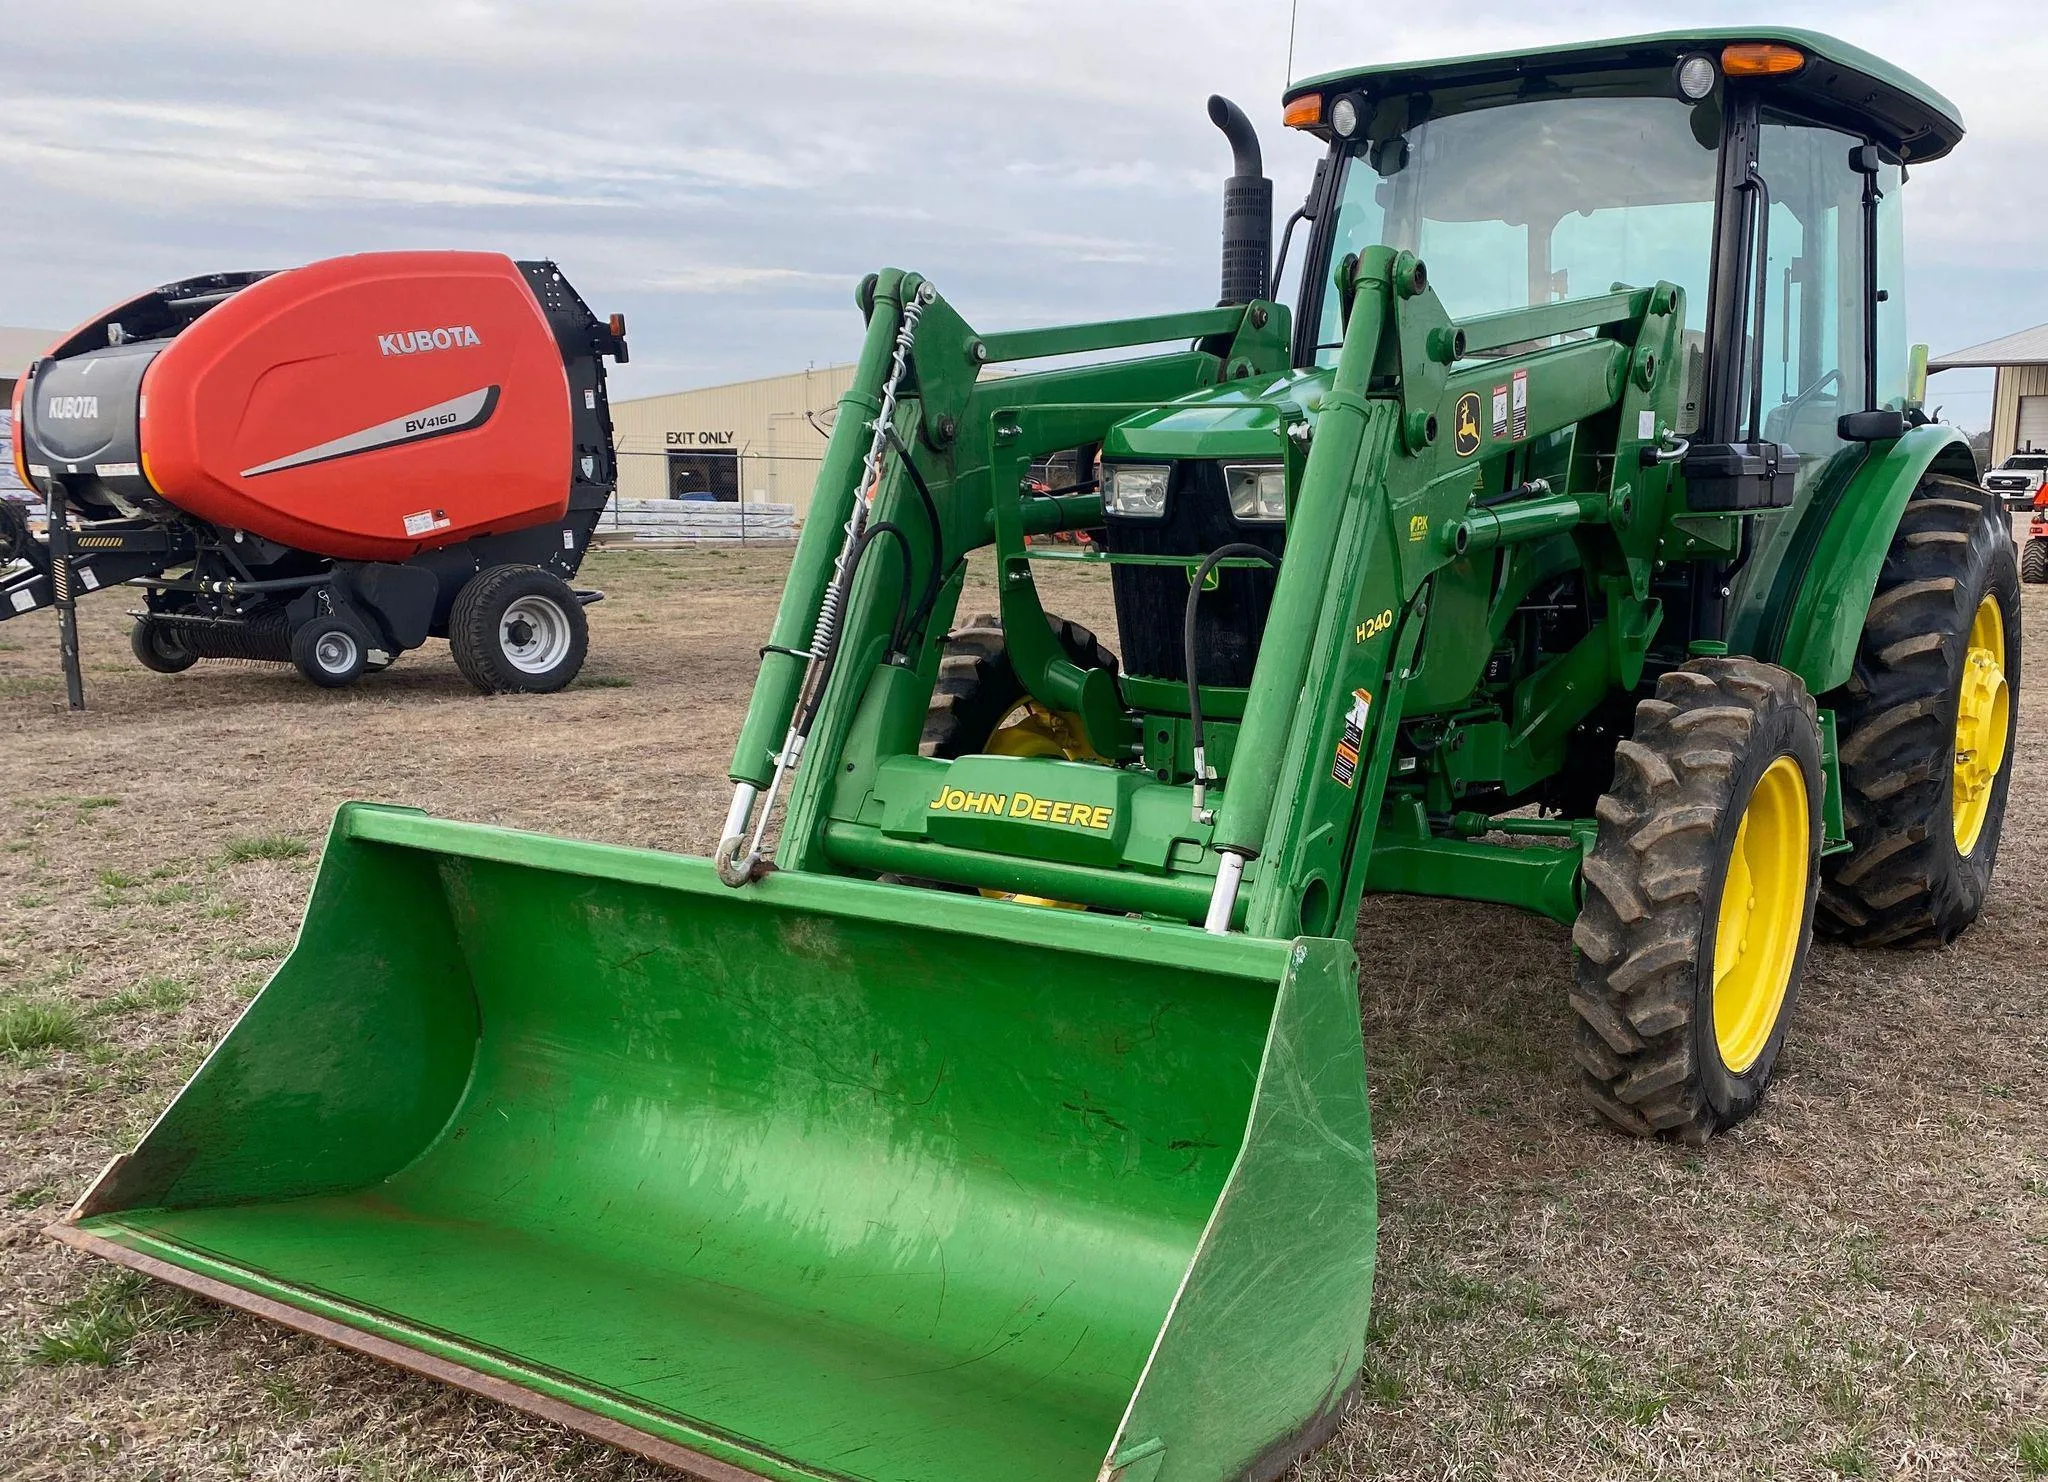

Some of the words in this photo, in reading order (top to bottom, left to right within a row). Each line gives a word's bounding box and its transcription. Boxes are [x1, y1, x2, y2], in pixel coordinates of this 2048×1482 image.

[378, 325, 481, 356] KUBOTA
[48, 396, 98, 419] KUBOTA
[405, 413, 457, 433] BV4160
[666, 431, 695, 444] EXIT
[698, 431, 734, 444] ONLY
[1355, 608, 1393, 645] H240
[929, 785, 1007, 816] JOHN
[1008, 792, 1114, 830] DEERE
